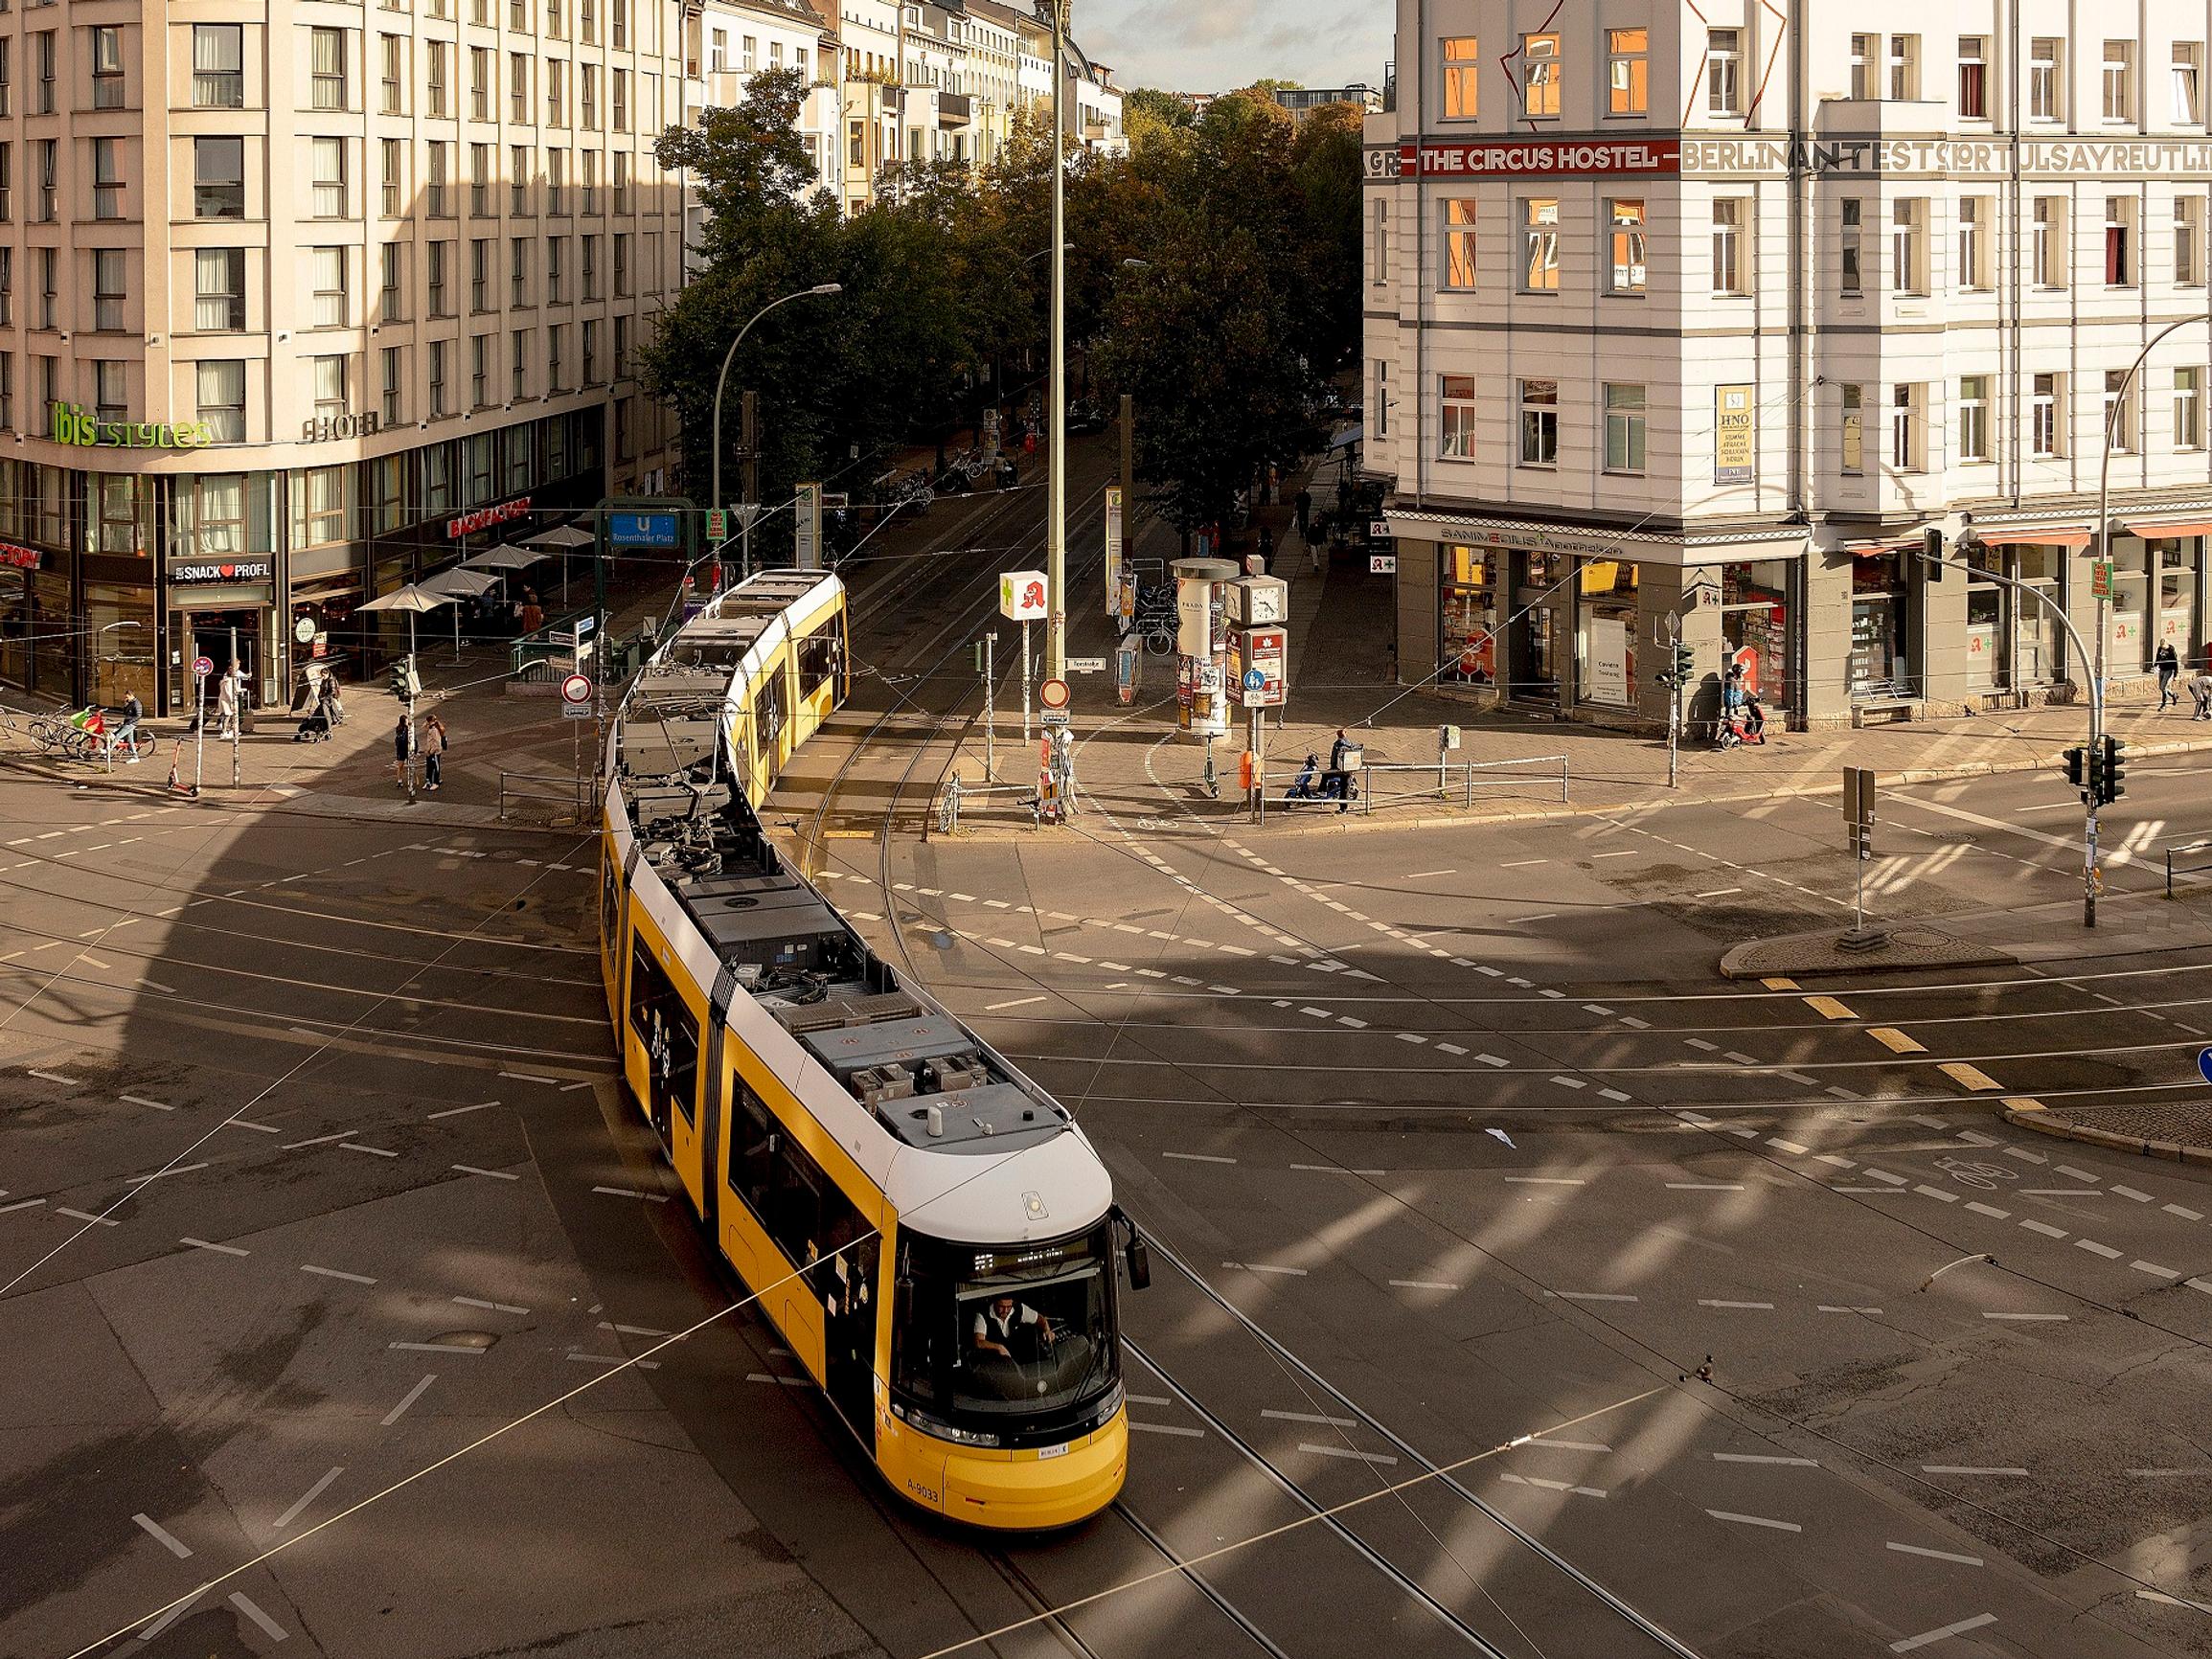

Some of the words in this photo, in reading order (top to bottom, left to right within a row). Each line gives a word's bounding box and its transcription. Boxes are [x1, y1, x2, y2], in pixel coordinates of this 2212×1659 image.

[1420, 149, 1464, 170] THE
[1468, 148, 1553, 170] CIRCUS
[1559, 146, 1658, 170] HOSTEL
[54, 400, 98, 445] ibis
[1721, 414, 1749, 425] HNO
[612, 533, 654, 543] Rosenthaler
[656, 534, 673, 543] Platz
[1540, 537, 1623, 556] Apotheken
[184, 565, 221, 580] SNACK
[907, 1478, 939, 1503] A-9033
